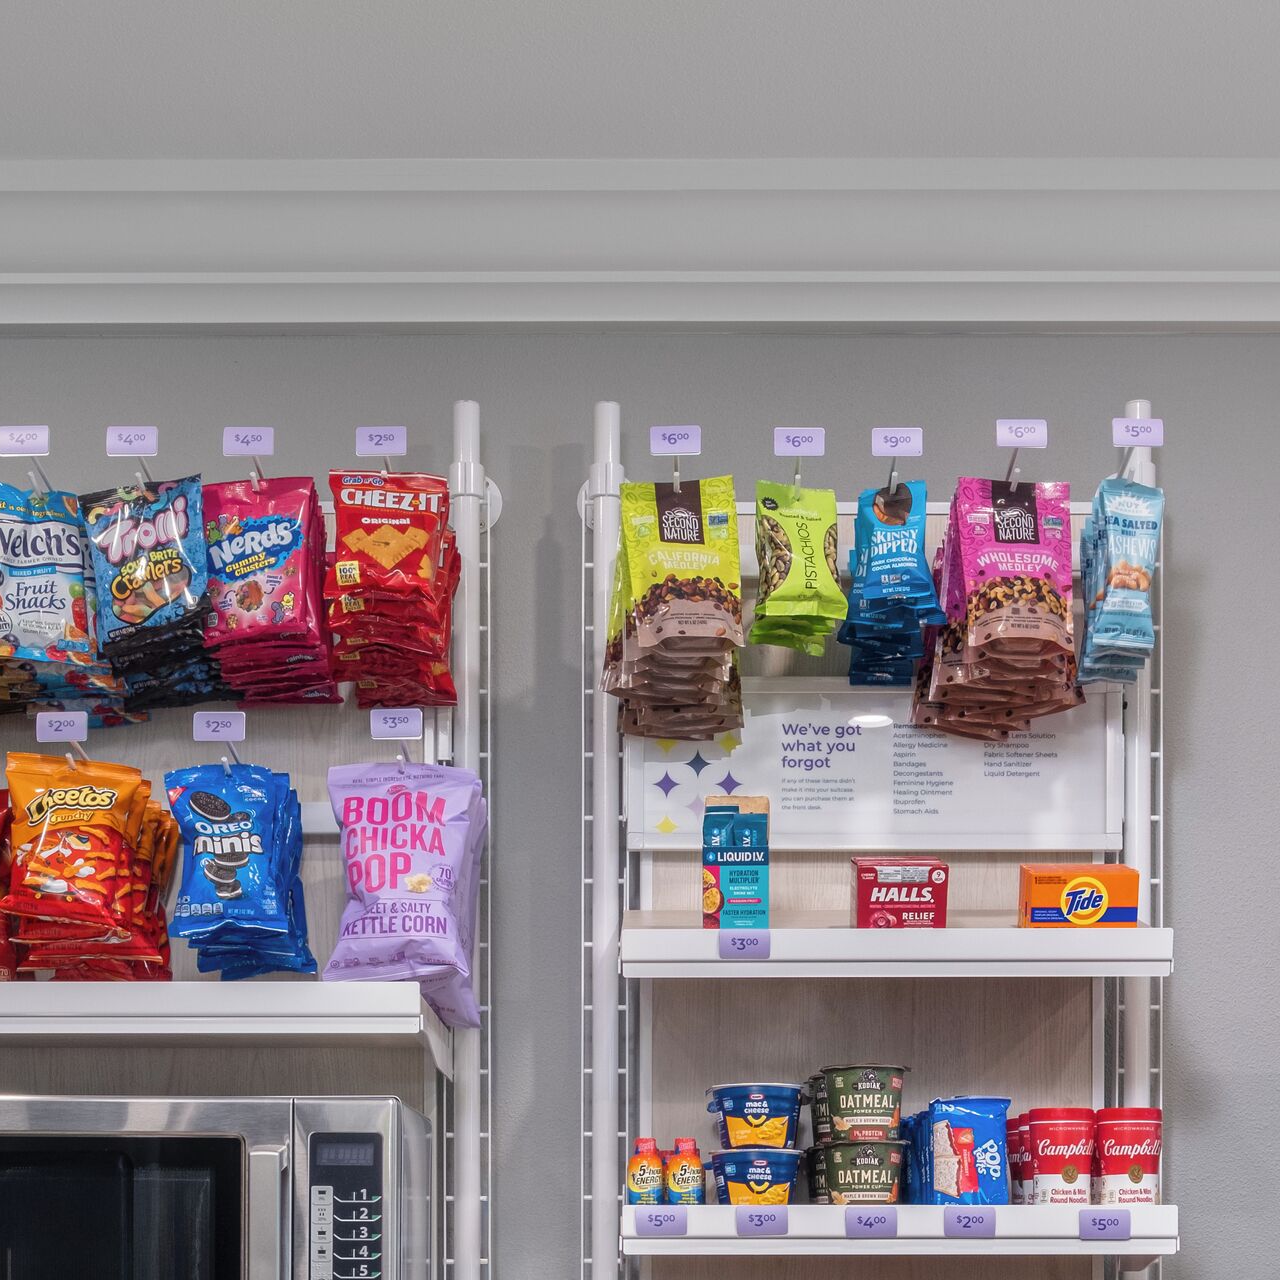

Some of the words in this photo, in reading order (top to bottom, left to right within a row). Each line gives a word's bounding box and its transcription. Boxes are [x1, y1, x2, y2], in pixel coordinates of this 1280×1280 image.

[1008, 426, 1036, 439] $600
[1125, 425, 1152, 438] $500
[661, 432, 689, 445] $600
[785, 435, 814, 448] $600
[883, 436, 911, 448] $900
[662, 514, 699, 531] SECOND
[996, 515, 1034, 530] SECOND
[1121, 519, 1158, 531] SALTED
[94, 495, 188, 565] Trolli
[663, 525, 700, 542] NATURE
[998, 526, 1035, 541] NATURE
[871, 529, 918, 545] SKINNY
[871, 539, 918, 557] DIPPED
[149, 549, 179, 562] BRITE
[796, 522, 818, 589] PISTACHIOS
[977, 551, 1059, 573] WHOLESOME
[998, 561, 1042, 573] MEDLEY
[16, 580, 58, 597] Fruit
[5, 594, 66, 610] Snacks
[48, 719, 75, 732] $200
[205, 719, 232, 733] $250
[382, 715, 409, 729] $350
[782, 723, 830, 736] We've
[835, 724, 862, 741] got
[893, 732, 947, 741] Acetaminophen
[782, 739, 823, 752] what
[826, 742, 856, 757] you
[893, 742, 915, 751] Allergy
[997, 742, 1029, 750] Shampoo
[893, 751, 916, 760] Aspirin
[781, 755, 831, 771] forgot
[893, 761, 926, 769] Bandages
[893, 770, 943, 779] Decongestants
[984, 770, 1003, 779] Liquid
[1005, 770, 1040, 779] Detergent
[926, 780, 954, 788] Hygiene
[893, 789, 919, 798] Healing
[25, 785, 118, 826] Cheetos
[342, 791, 446, 827] BOOM
[893, 798, 926, 807] Ibuprofen
[50, 811, 94, 824] Crunchy
[195, 821, 252, 834] OREO
[193, 831, 264, 856] minis
[346, 823, 446, 859] CHICKA
[717, 852, 751, 862] LIQUID
[347, 852, 412, 899] POP
[870, 887, 934, 903] HALLS
[401, 903, 432, 913] SALTY
[1065, 888, 1104, 917] Tide
[902, 912, 935, 920] RELIEF
[343, 916, 397, 935] KETTLE
[401, 915, 447, 935] CORN
[731, 938, 759, 951] $300
[858, 1082, 881, 1090] KODIAK
[840, 1094, 895, 1109] OATMEAL
[856, 1157, 879, 1166] KODIAK
[838, 1170, 893, 1184] OATMEAL
[360, 1189, 367, 1199] 1
[360, 1208, 368, 1219] 2
[748, 1214, 776, 1226] $300
[648, 1214, 676, 1227] $500
[857, 1215, 886, 1228] $400
[956, 1215, 984, 1228] $200
[1091, 1218, 1119, 1231] $500
[360, 1227, 368, 1238] 3
[359, 1246, 368, 1257] 4
[360, 1265, 368, 1276] 5
